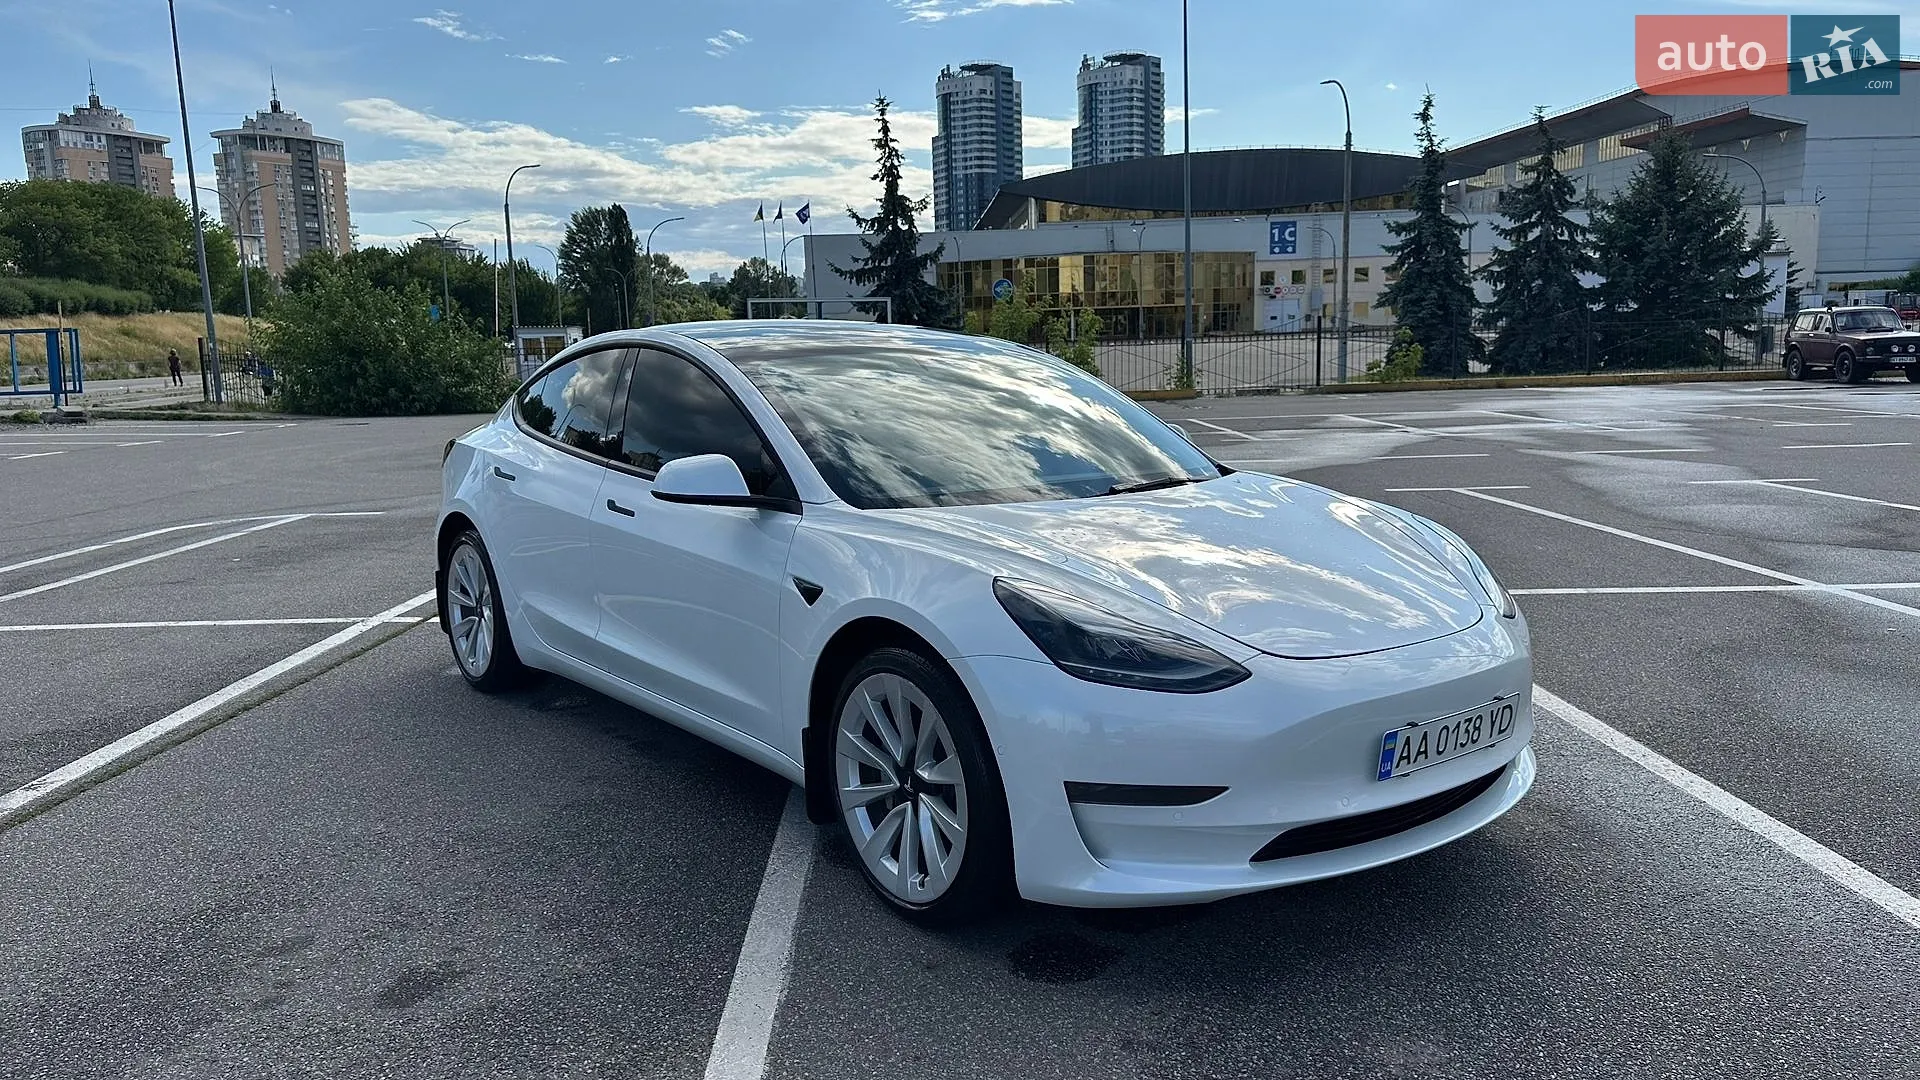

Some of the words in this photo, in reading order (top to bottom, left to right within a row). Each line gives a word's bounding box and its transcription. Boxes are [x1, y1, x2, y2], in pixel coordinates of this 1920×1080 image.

[1395, 730, 1429, 769] AA
[1436, 713, 1484, 756] 0138
[1488, 703, 1514, 739] YD
[1380, 761, 1391, 773] UA
